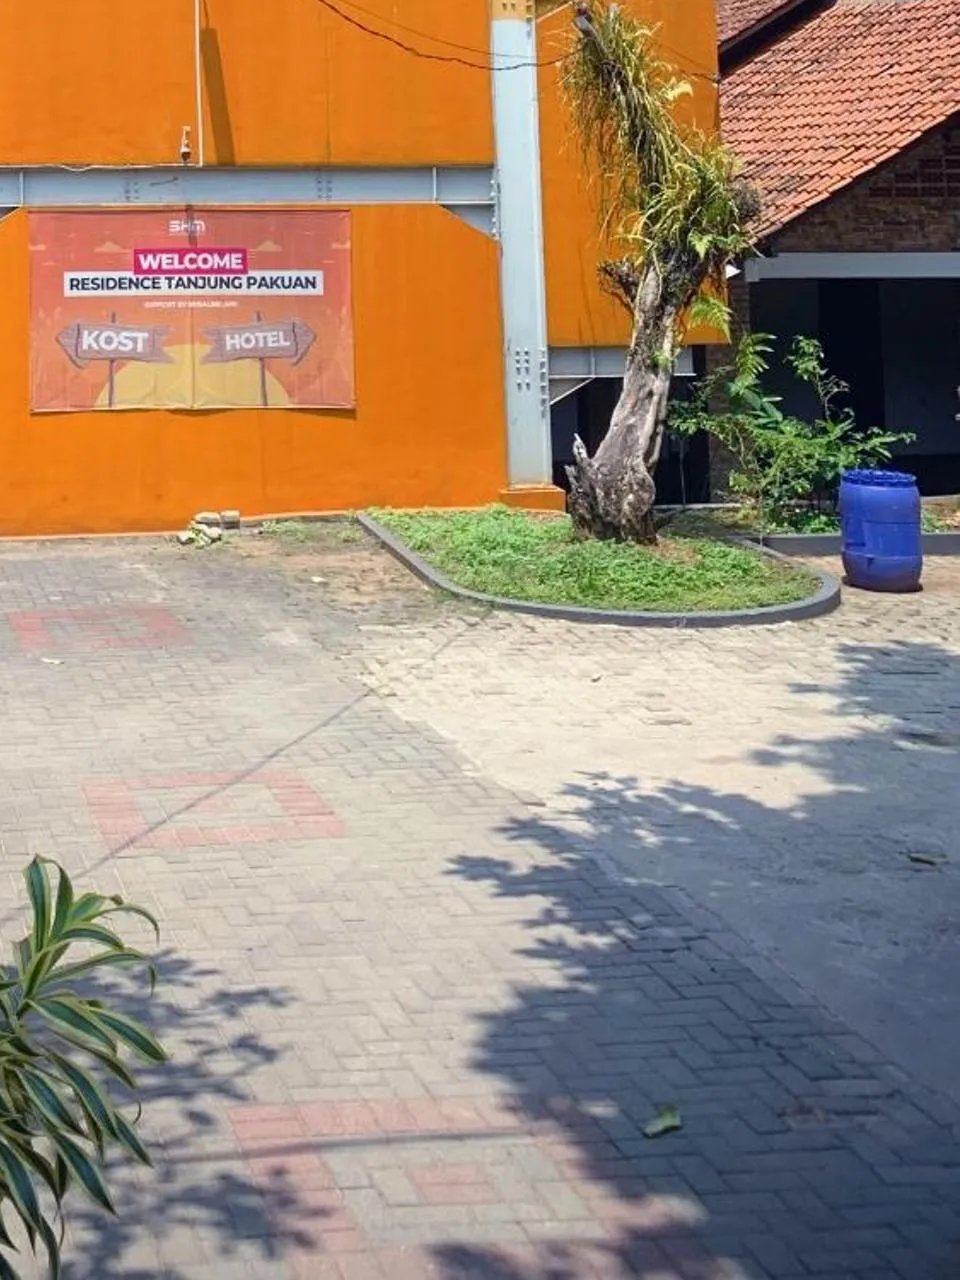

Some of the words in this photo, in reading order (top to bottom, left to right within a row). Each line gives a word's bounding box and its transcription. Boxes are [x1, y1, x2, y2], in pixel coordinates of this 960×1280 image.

[138, 253, 243, 269] WELCOME
[69, 277, 161, 290] RESIDENCE
[165, 276, 242, 289] TANJUNG
[246, 276, 316, 289] PAKUAN
[82, 330, 149, 353] KOST
[225, 331, 291, 351] HOTEL
